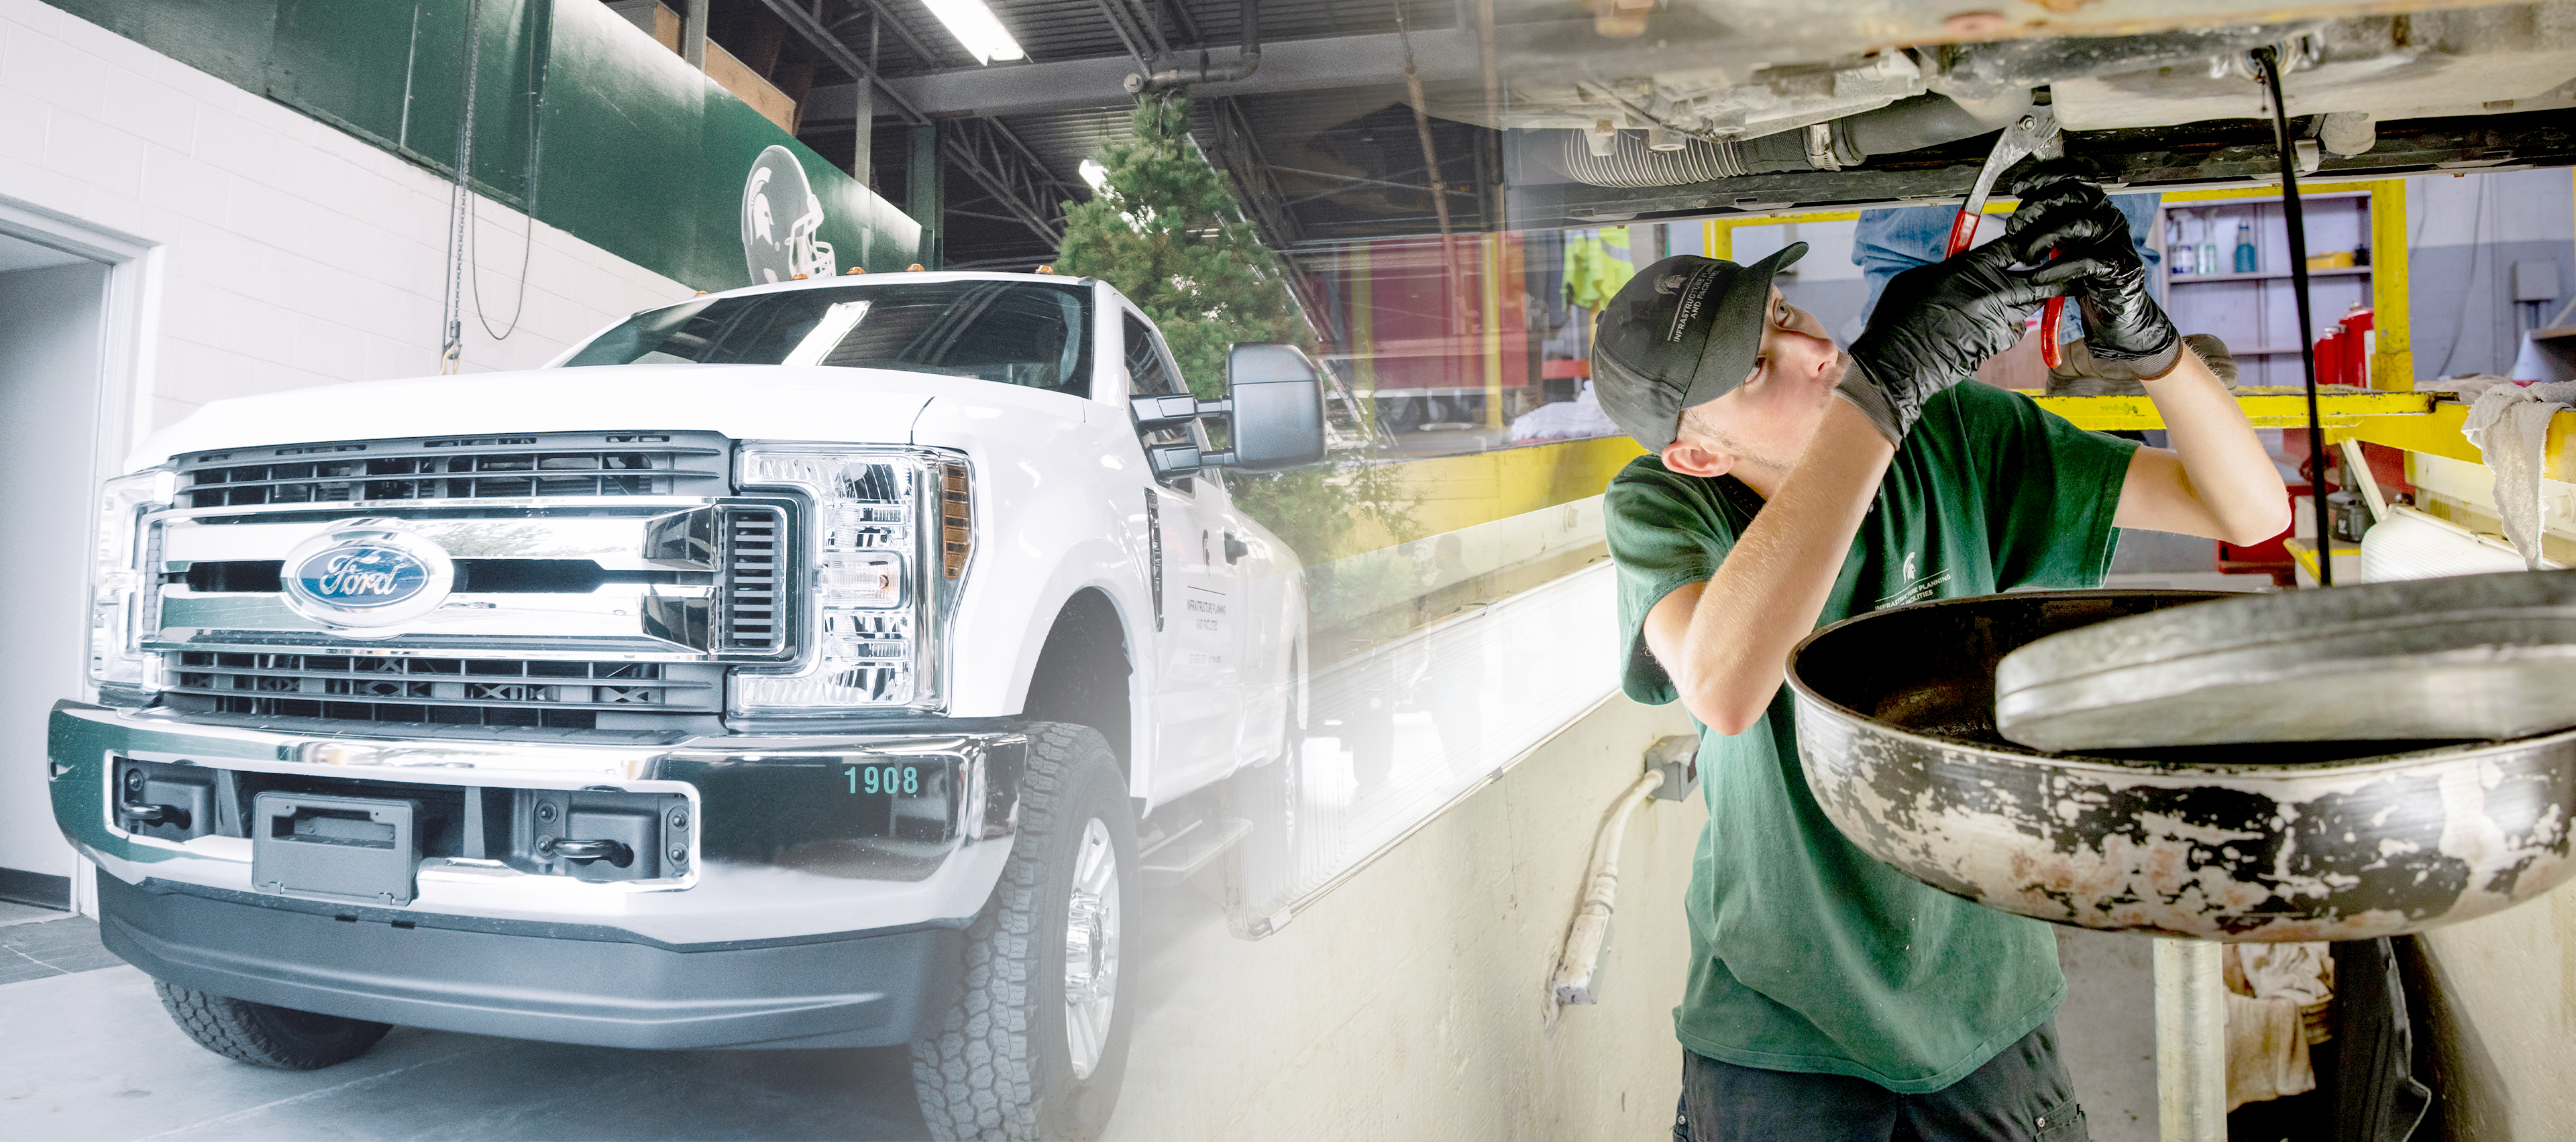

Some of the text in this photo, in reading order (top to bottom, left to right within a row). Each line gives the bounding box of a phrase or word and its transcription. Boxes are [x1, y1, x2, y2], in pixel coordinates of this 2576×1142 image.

[1673, 278, 1705, 343] INFRASTRUCTURE
[1690, 301, 1702, 319] AND
[319, 555, 401, 595] Ford
[1875, 574, 1951, 611] INFRASTRUCTURE PLANNING
[1905, 589, 1933, 605] FACILITIES
[845, 766, 918, 794] 1908
